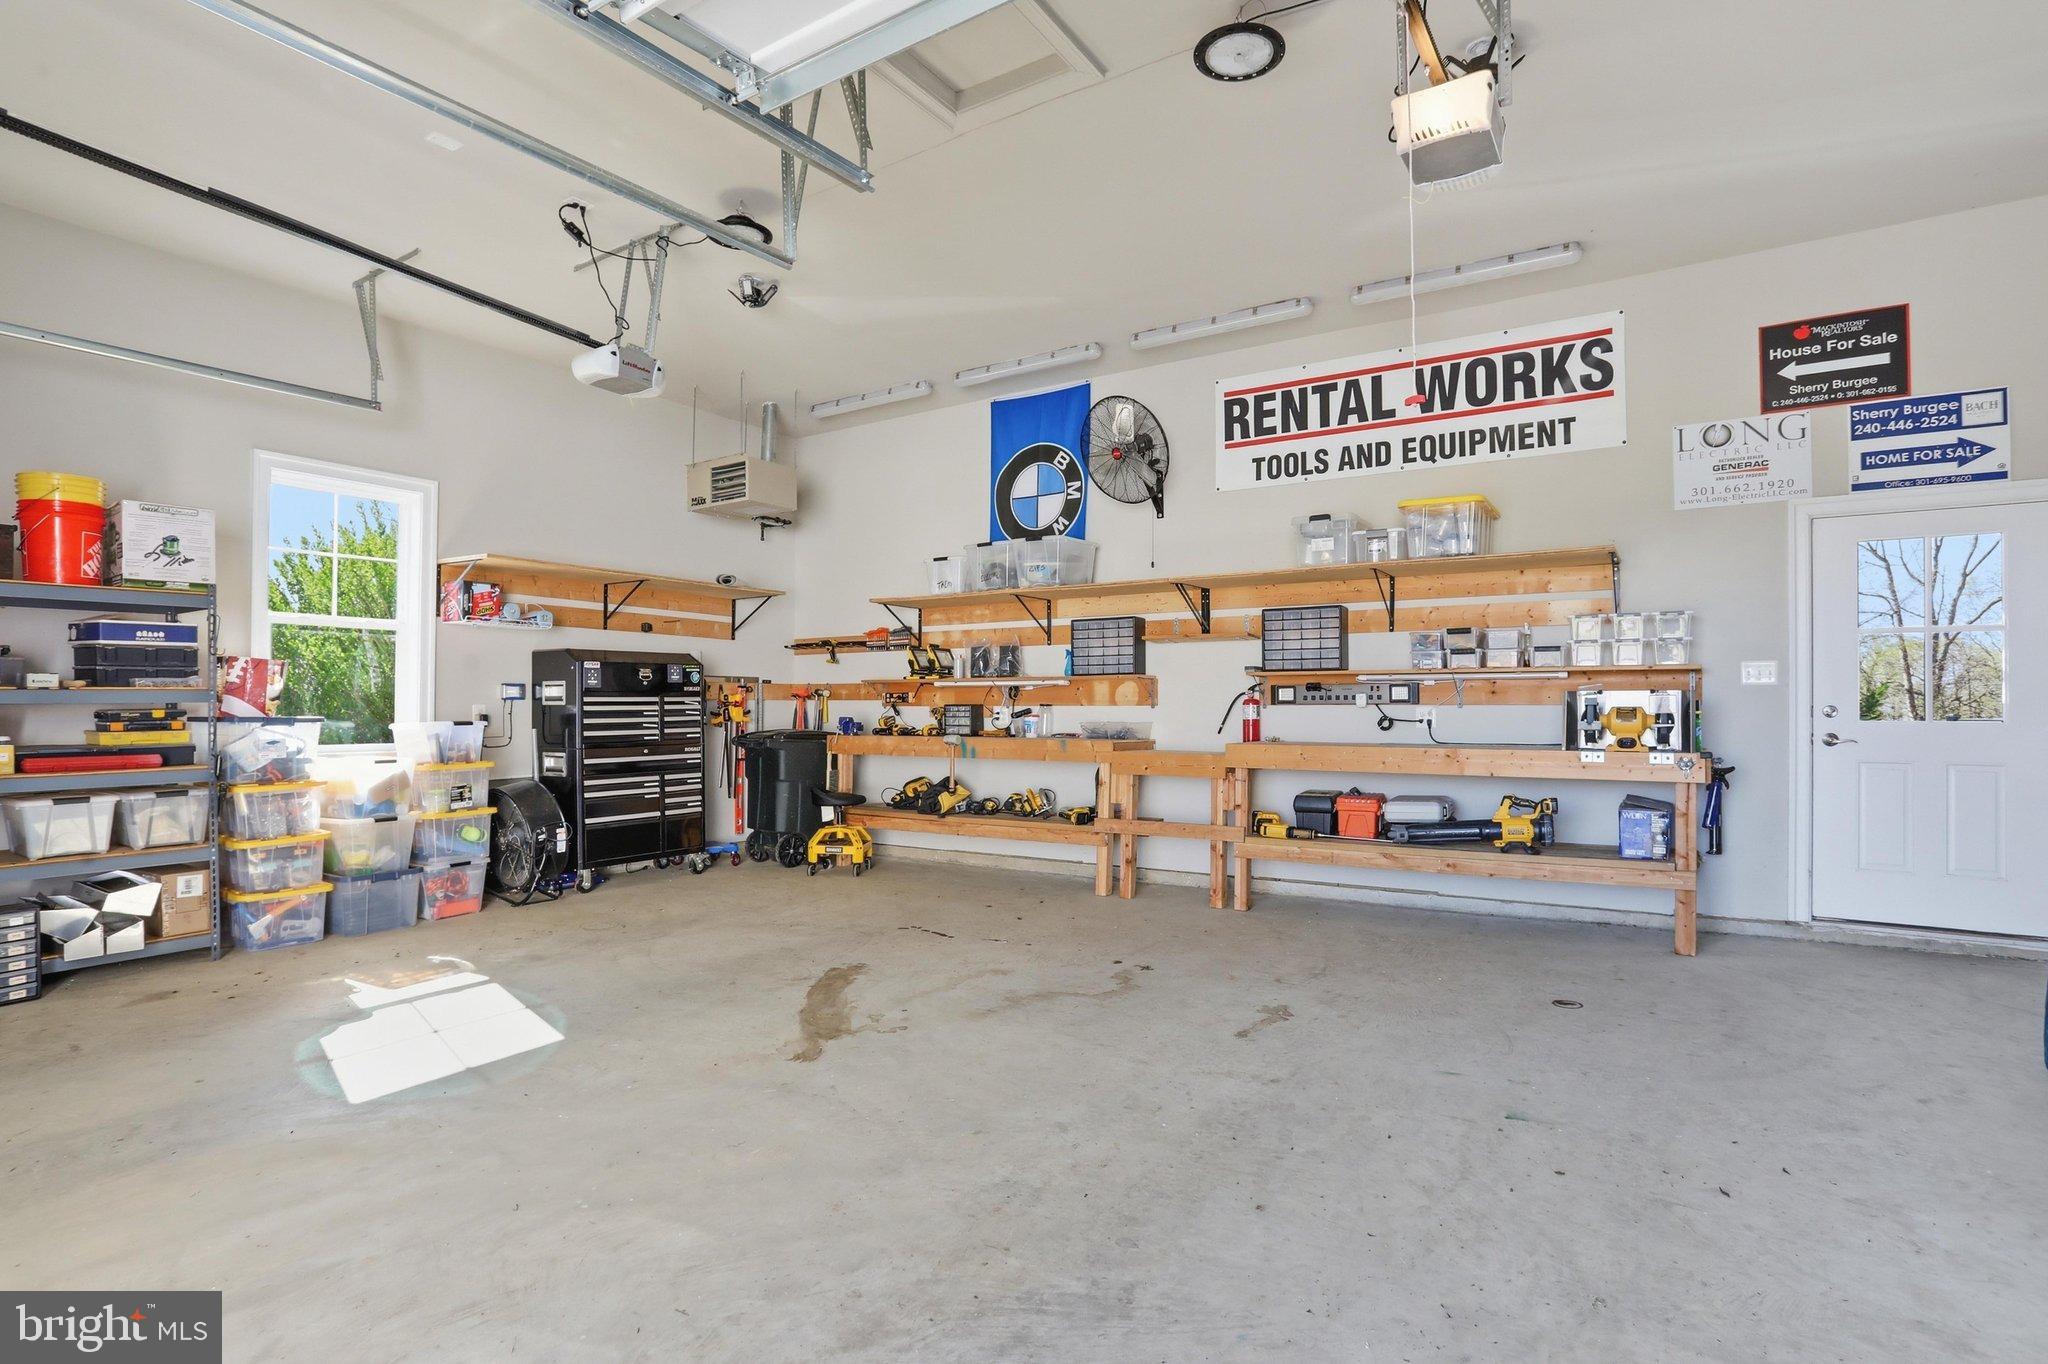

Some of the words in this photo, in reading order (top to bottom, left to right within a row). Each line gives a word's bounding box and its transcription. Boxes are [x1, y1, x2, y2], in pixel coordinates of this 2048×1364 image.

[1769, 343, 1822, 361] House
[1826, 338, 1856, 352] For
[1860, 332, 1898, 347] Sale
[1224, 374, 1396, 442] RENTAL
[1415, 337, 1614, 414] WORKS
[1789, 382, 1828, 396] Sherry
[1832, 376, 1878, 390] Burgee
[1852, 407, 1899, 421] Sherry
[1903, 401, 1960, 415] Burgee
[1965, 400, 1999, 412] BACH
[1677, 413, 1807, 453] LONG
[1854, 414, 1958, 436] 240-446-2524
[1252, 448, 1329, 481] TOOLS
[1338, 440, 1391, 472] AND
[1402, 416, 1576, 464] EQUIPMENT
[1679, 445, 1763, 461] ELECTRIC
[1866, 452, 1909, 466] HOME
[1913, 449, 1941, 462] FOR
[1946, 445, 1981, 459] SALE
[1712, 459, 1769, 472] GENERAC
[1691, 478, 1795, 497] 301.662.1920
[1884, 478, 1914, 488] Office:
[1916, 474, 1972, 486] 301-695-9600
[1053, 450, 1082, 536] BMW
[1680, 487, 1808, 505] www.Long-ElectricLLC.com
